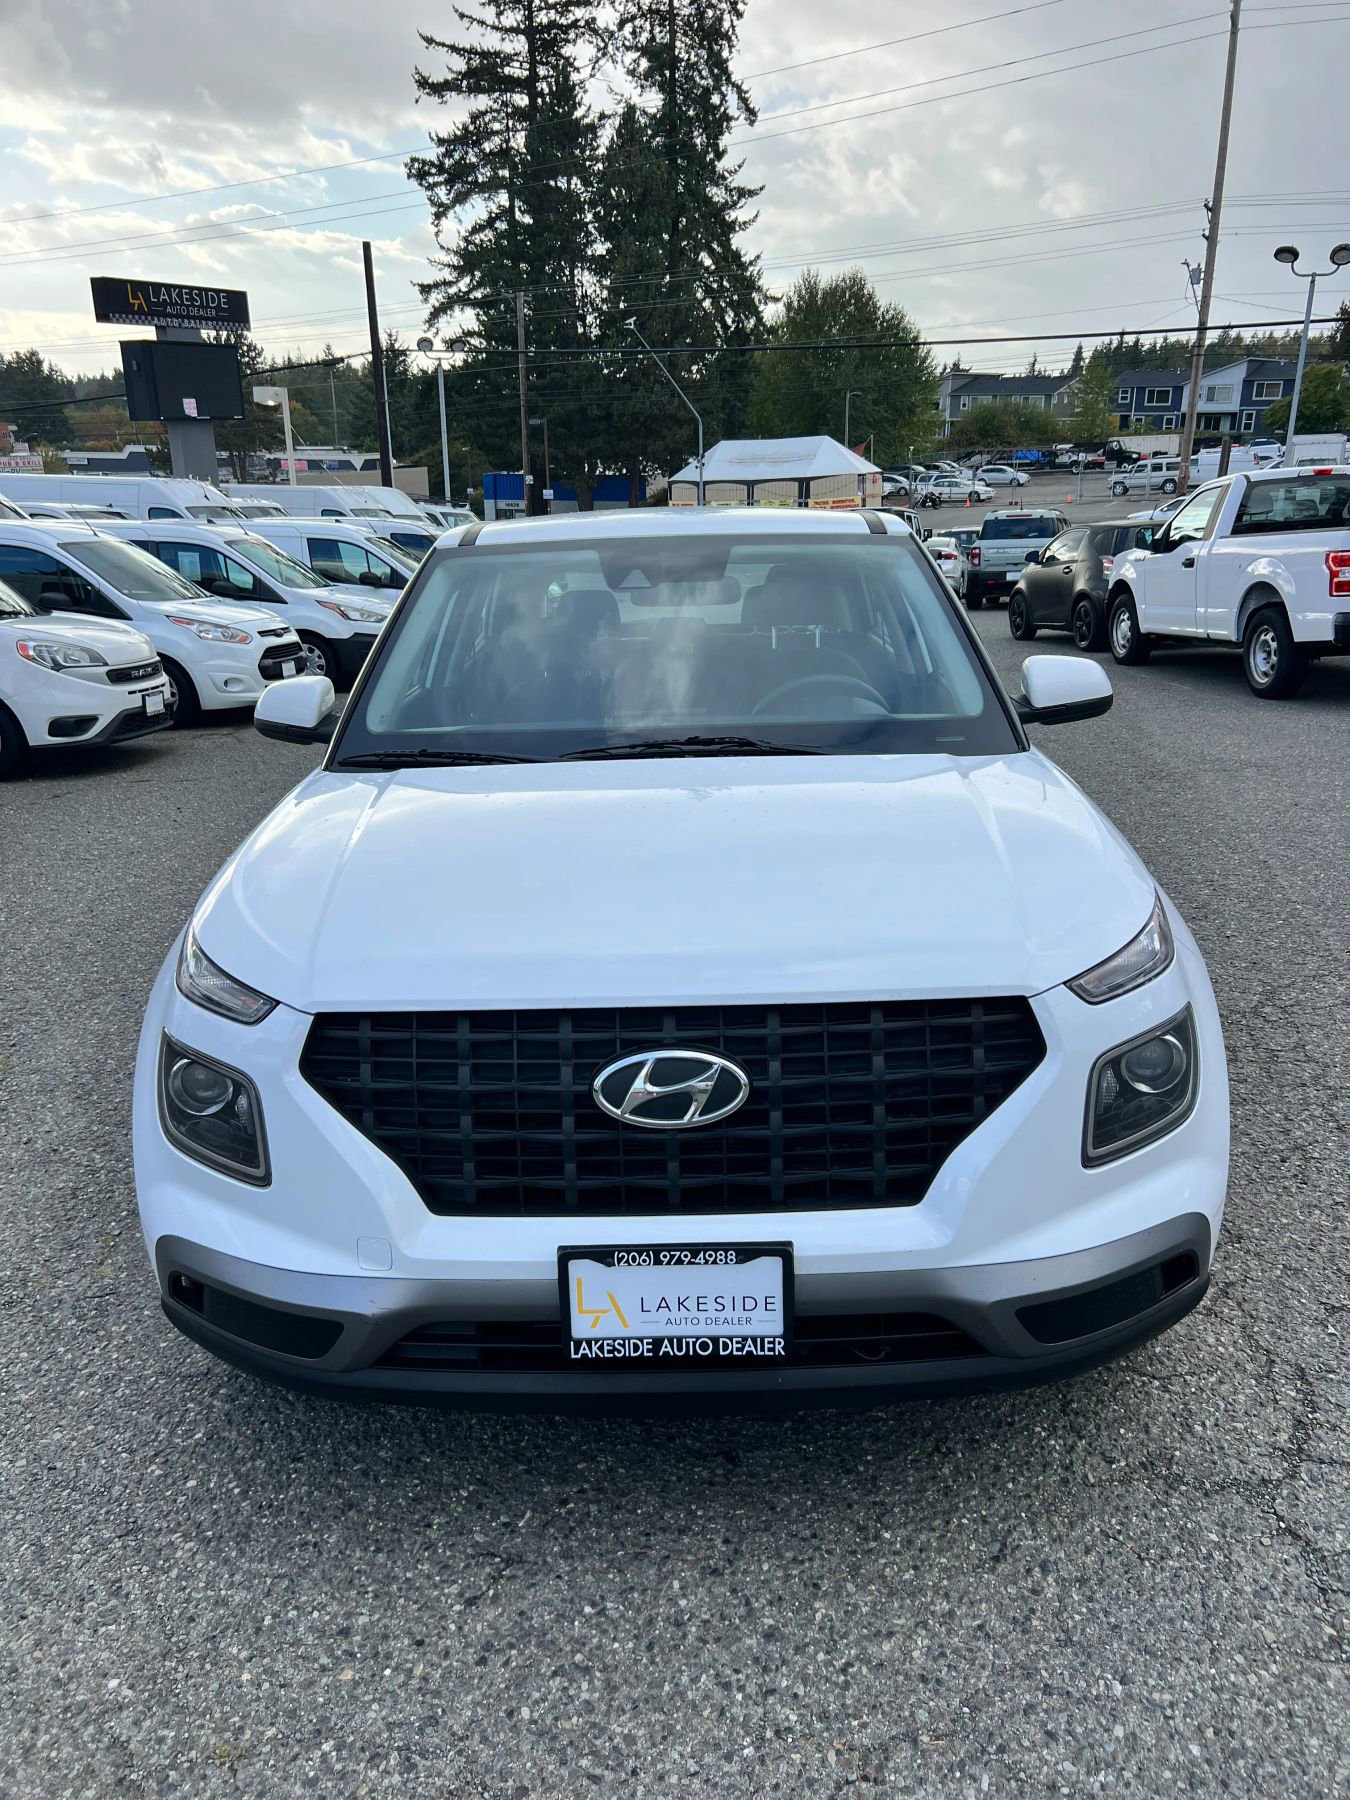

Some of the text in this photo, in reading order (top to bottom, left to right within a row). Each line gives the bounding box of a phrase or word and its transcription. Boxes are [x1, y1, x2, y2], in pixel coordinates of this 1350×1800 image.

[149, 285, 229, 308] LAKESIDE
[166, 305, 217, 317] AUTO DEALER
[153, 317, 214, 329] AUTO SALES
[131, 667, 153, 678] RAM
[614, 1250, 737, 1267] (206) 979-4988
[640, 1295, 777, 1313] LAKESIDE
[665, 1316, 753, 1326] AUTO DEALER
[570, 1336, 786, 1359] LAKESIDE AUTO DEALER
